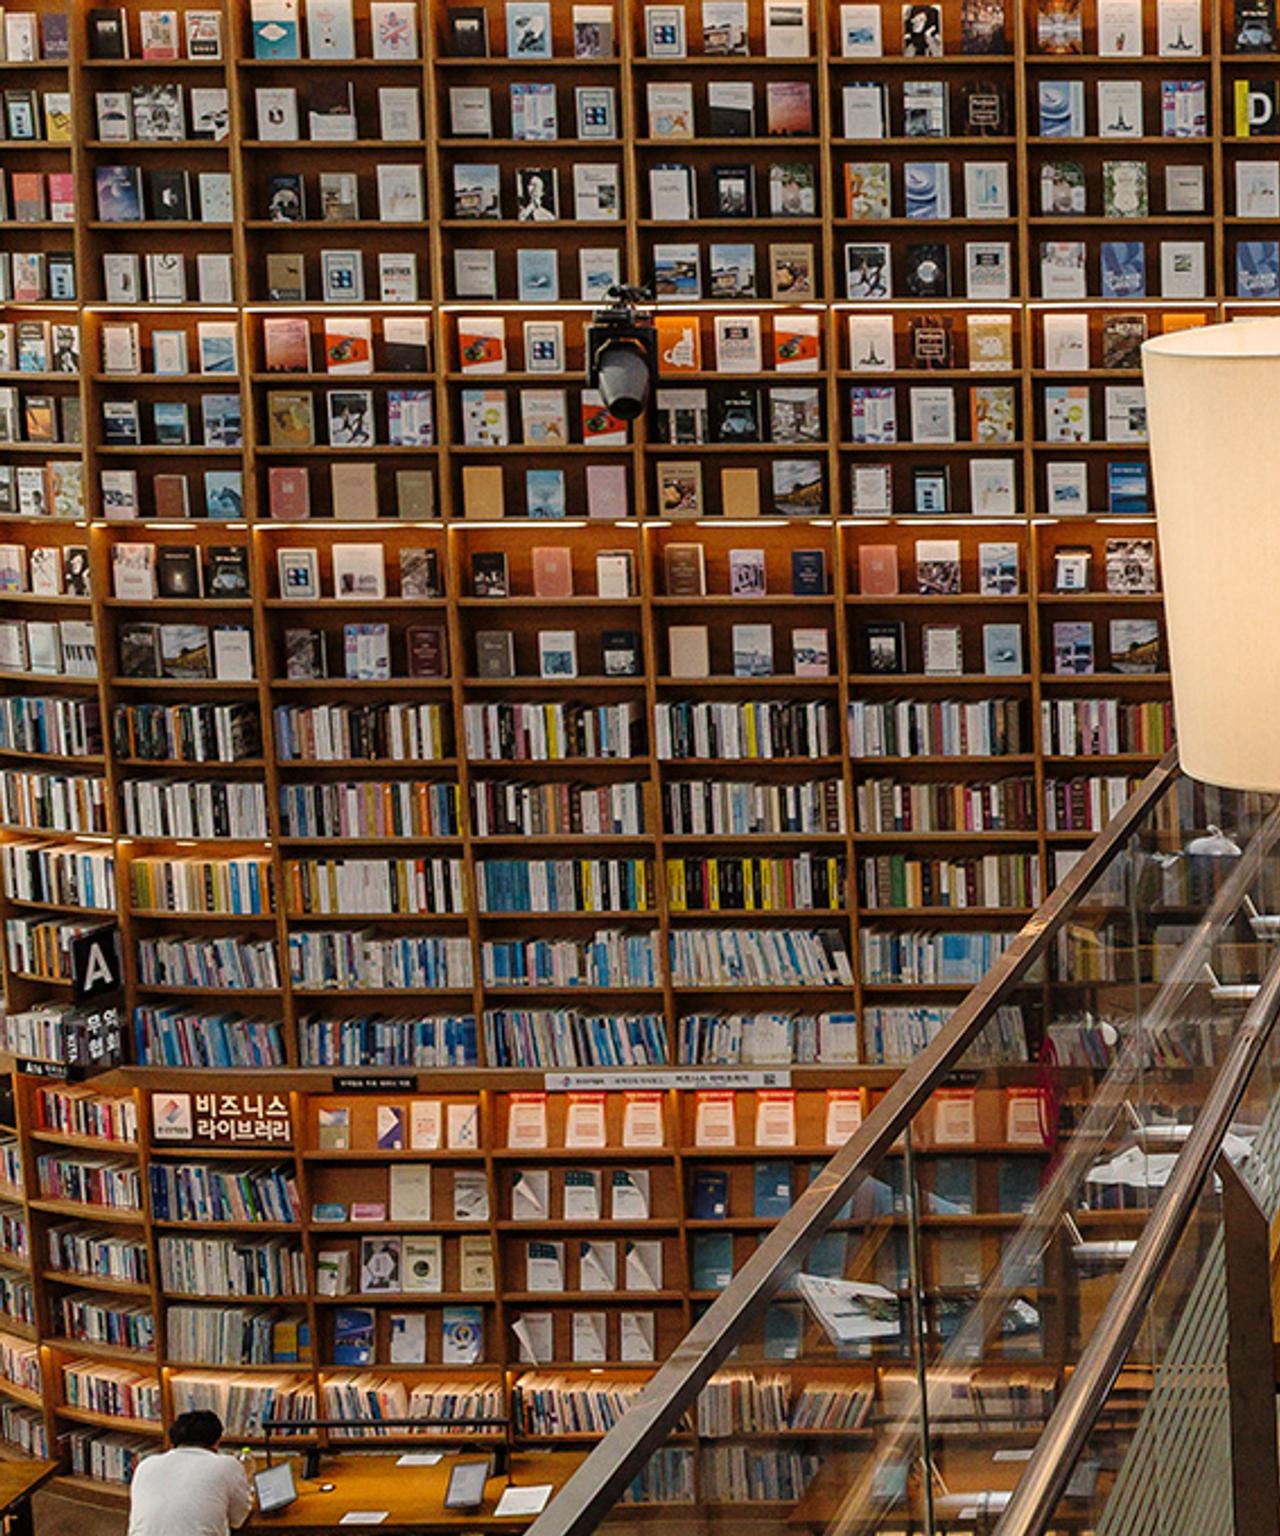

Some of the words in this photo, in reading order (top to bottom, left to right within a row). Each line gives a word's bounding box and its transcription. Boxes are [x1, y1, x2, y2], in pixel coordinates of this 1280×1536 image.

[1248, 92, 1272, 125] D
[84, 943, 114, 992] A
[196, 1094, 288, 1118] 비즈니스
[197, 1119, 290, 1142] 라이브러리
